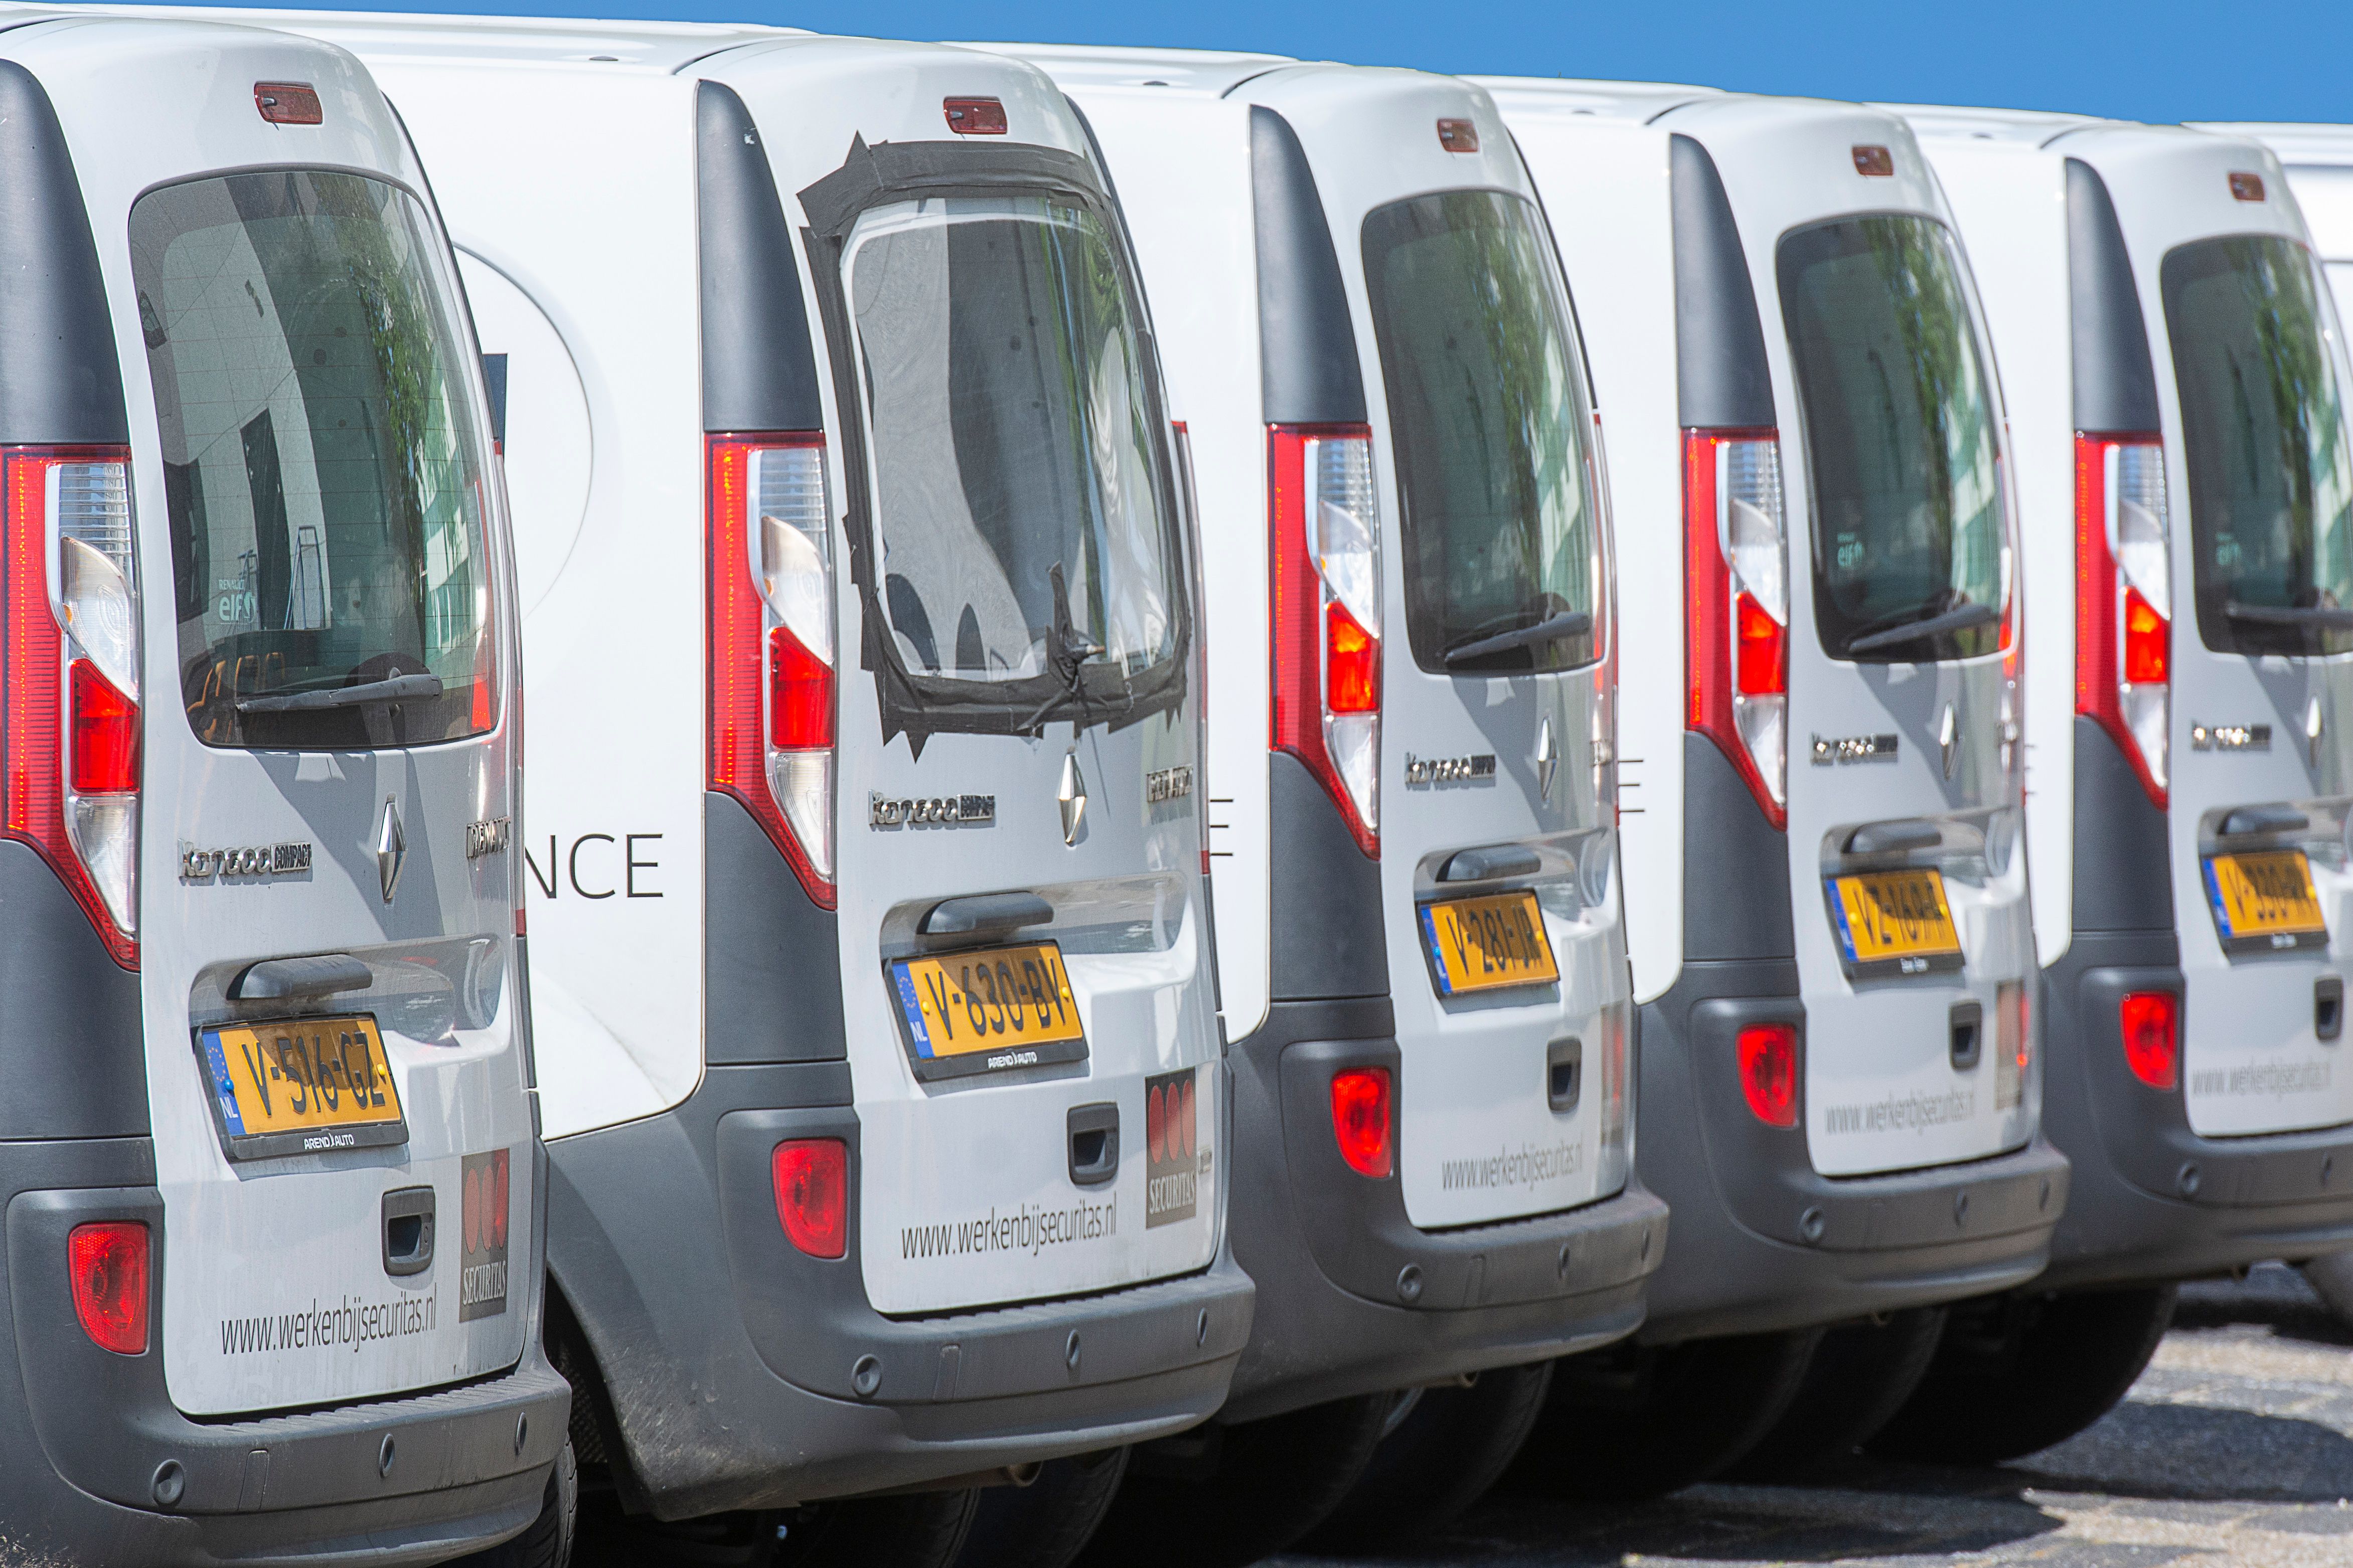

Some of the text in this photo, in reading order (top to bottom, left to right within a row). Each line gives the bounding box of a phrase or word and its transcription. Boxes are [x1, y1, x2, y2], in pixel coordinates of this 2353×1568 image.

[274, 843, 312, 870] COMPACT
[925, 958, 1066, 1040] V-630-BV
[910, 1021, 927, 1043] NL
[241, 1031, 385, 1118] V-516-GZ
[988, 1051, 1037, 1069] AREND AUTO
[219, 1096, 238, 1119] NL
[303, 1134, 355, 1150] AREND AUTO
[1150, 1170, 1195, 1214] SECURITAS
[902, 1191, 1117, 1260] www.werkenbijsecuritas.nl
[462, 1260, 506, 1305] SECURITAS
[222, 1283, 437, 1354] www.werkenbijsecuritas.nl
